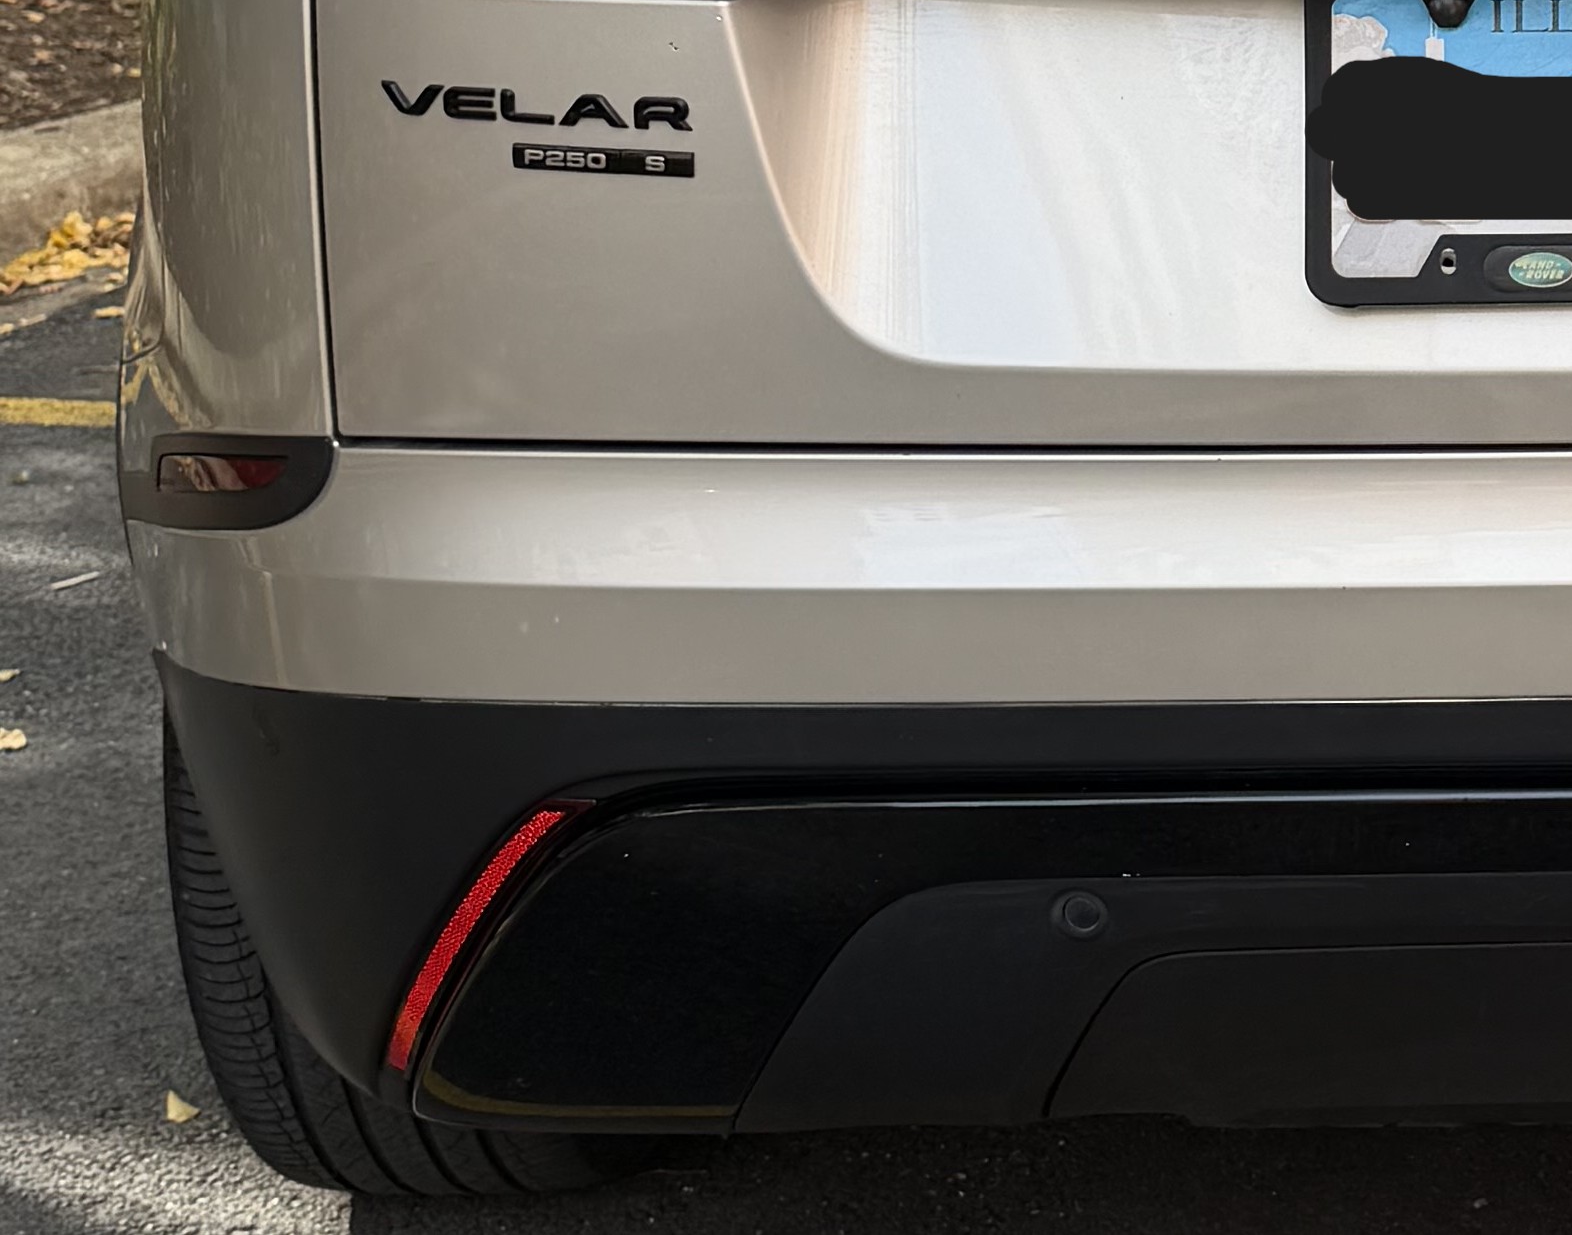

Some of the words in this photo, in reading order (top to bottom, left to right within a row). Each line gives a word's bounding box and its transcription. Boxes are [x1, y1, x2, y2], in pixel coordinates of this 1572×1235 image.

[380, 79, 694, 132] VELAR
[523, 148, 607, 170] P250
[644, 155, 666, 173] S
